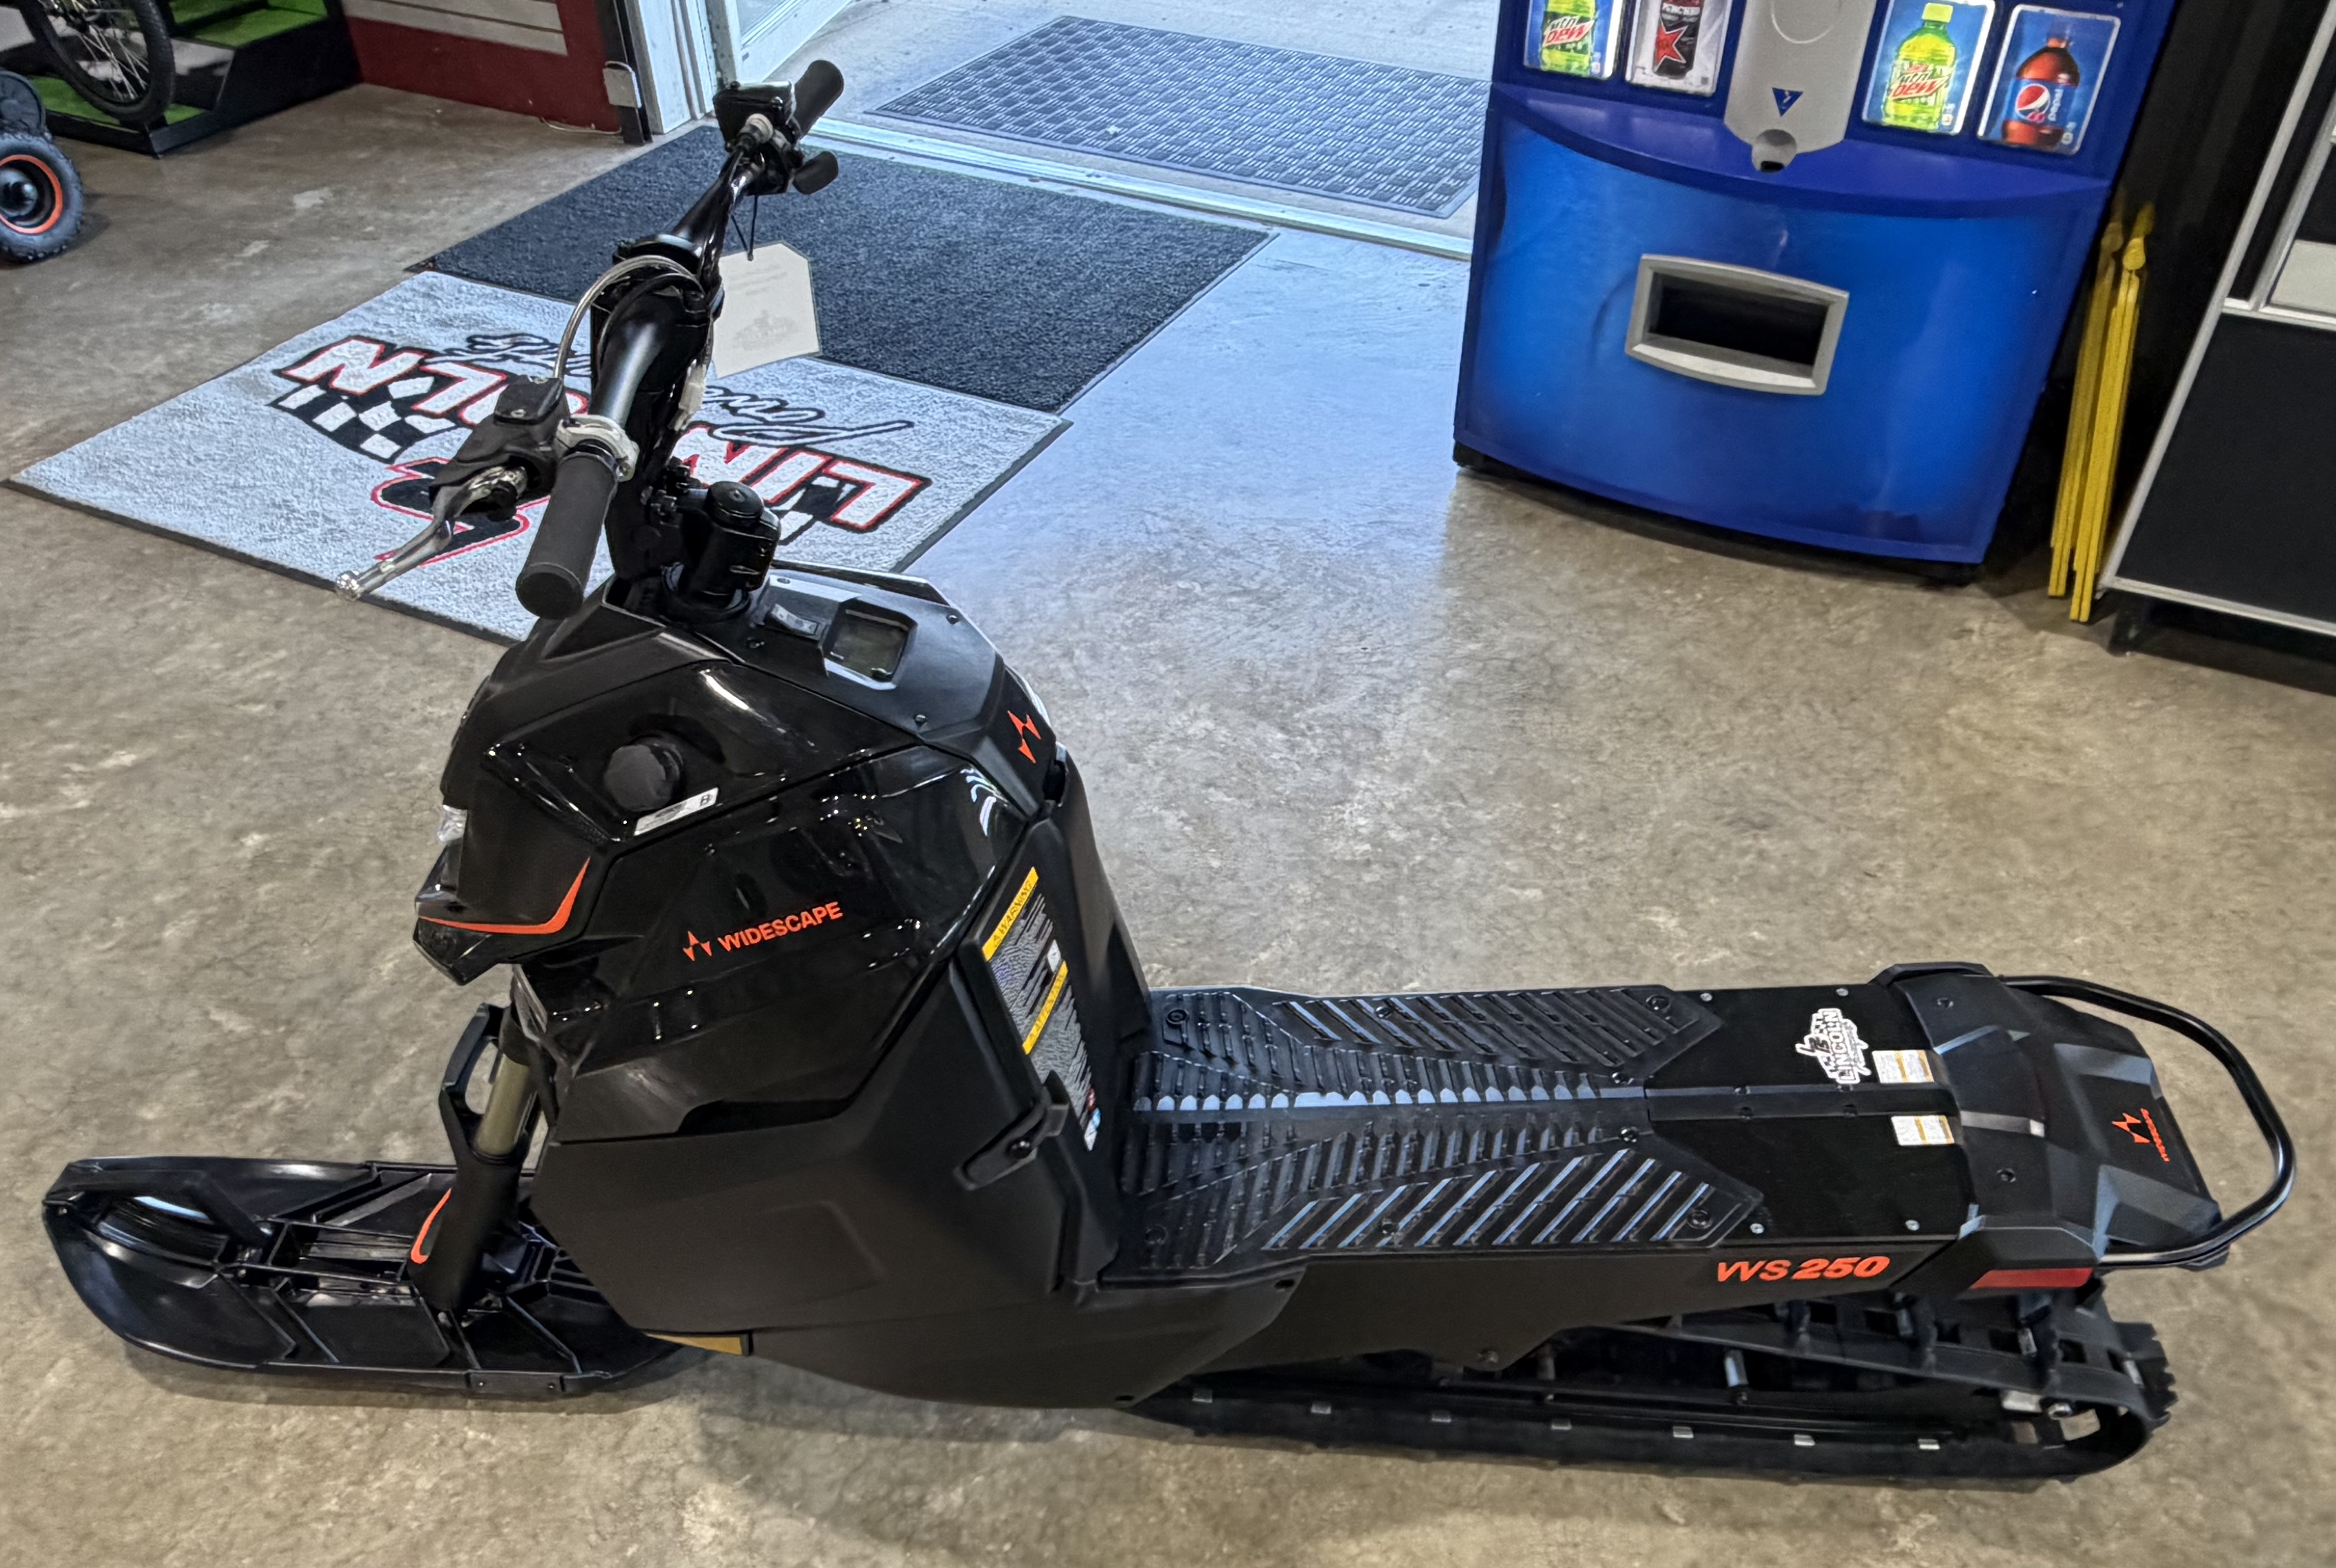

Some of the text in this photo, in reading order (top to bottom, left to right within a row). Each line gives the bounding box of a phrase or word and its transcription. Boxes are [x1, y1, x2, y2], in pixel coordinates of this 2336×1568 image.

[718, 902, 843, 952] WIDESCAPE
[1822, 1011, 1857, 1081] LINCOLN
[1717, 1256, 1890, 1282] WS 250
